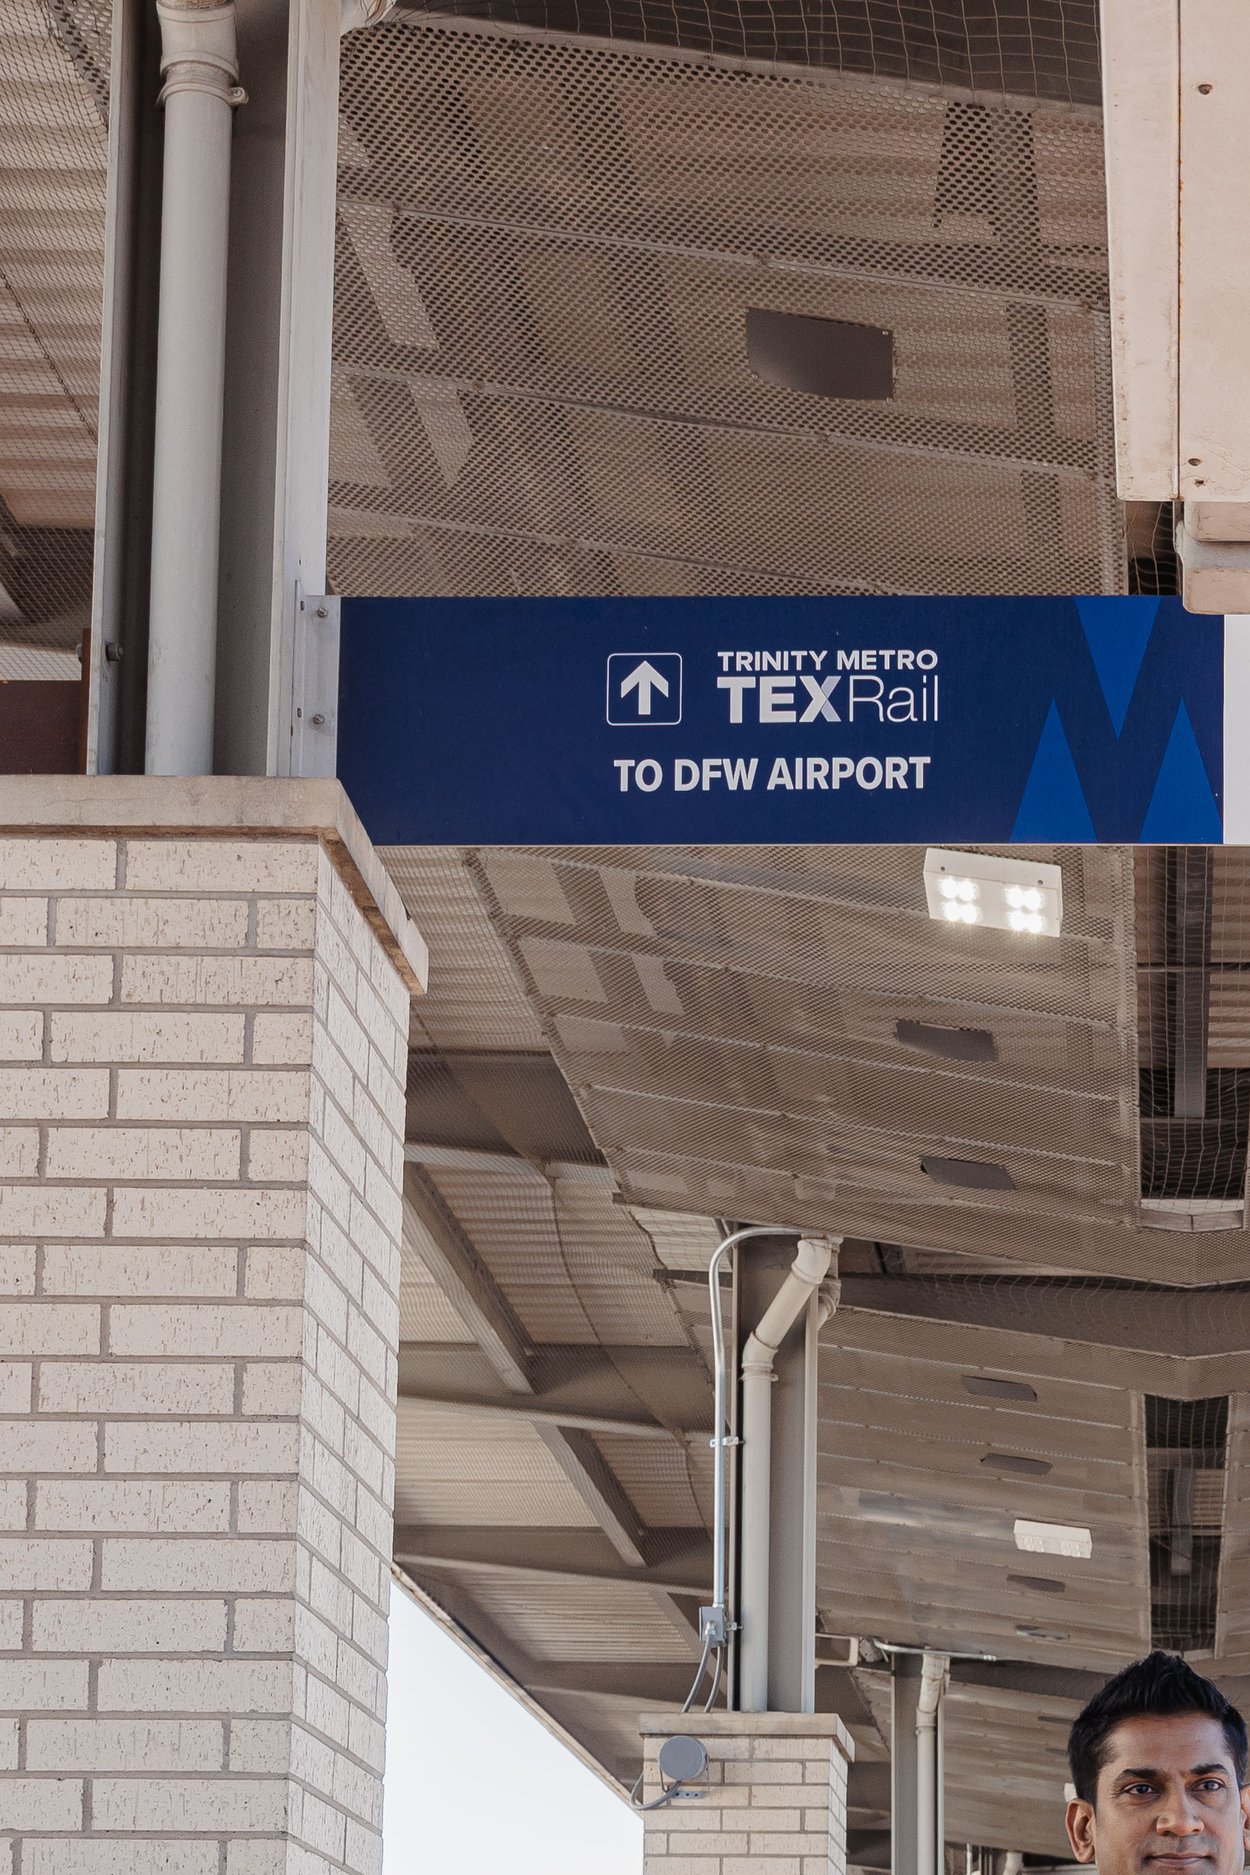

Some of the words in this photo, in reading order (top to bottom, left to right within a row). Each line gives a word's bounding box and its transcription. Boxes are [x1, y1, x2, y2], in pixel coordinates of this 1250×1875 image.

[717, 650, 828, 672] TRINITY
[836, 649, 939, 671] METRO
[613, 758, 663, 793] TO
[674, 757, 759, 792] DFW
[766, 756, 932, 791] AIRPORT
